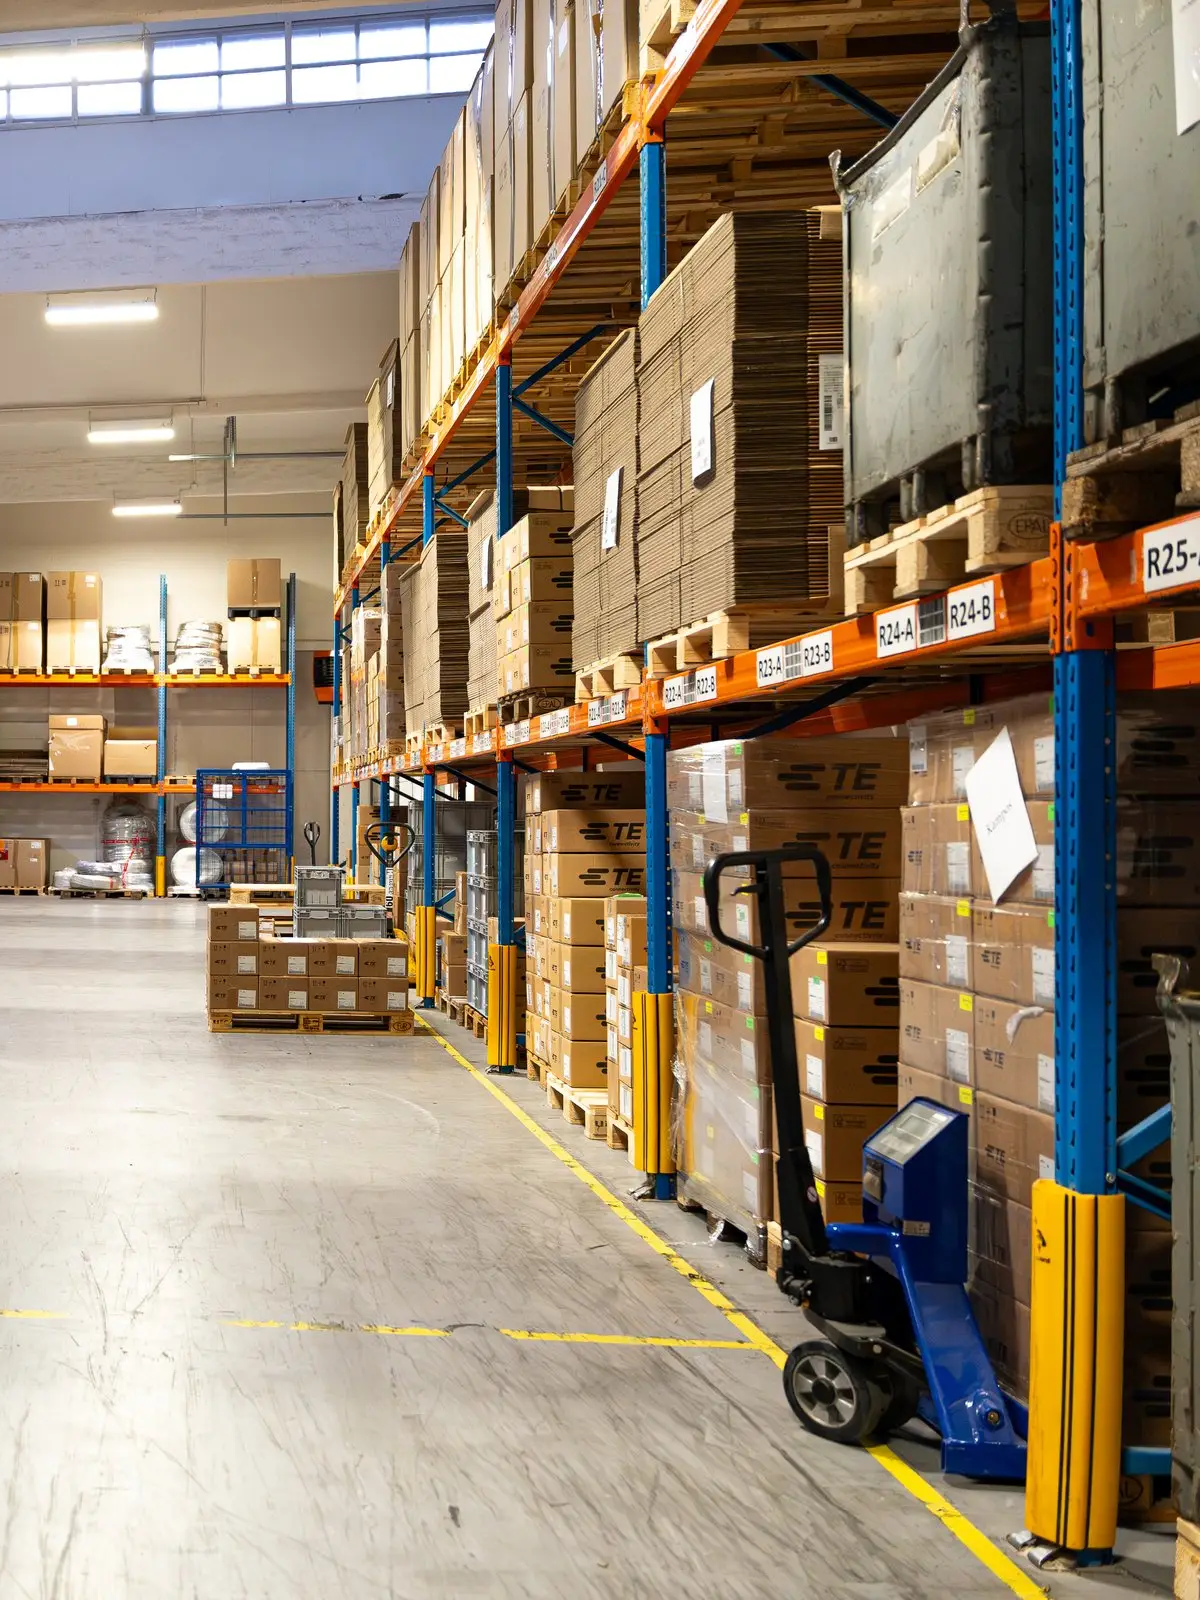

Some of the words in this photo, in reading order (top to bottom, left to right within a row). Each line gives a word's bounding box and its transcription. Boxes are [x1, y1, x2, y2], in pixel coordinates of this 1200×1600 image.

[1148, 540, 1200, 579] R25-
[879, 617, 914, 648] R24-A
[950, 594, 992, 630] R24-B
[758, 656, 782, 679] R23-A
[804, 642, 831, 668] R23-B
[665, 684, 682, 703] R22-A
[696, 675, 715, 695] R22-B
[831, 763, 882, 791] TE
[593, 784, 622, 801] TE
[613, 823, 644, 840] TE
[837, 832, 886, 859] TE
[612, 868, 644, 886] TE
[840, 901, 890, 929] TE
